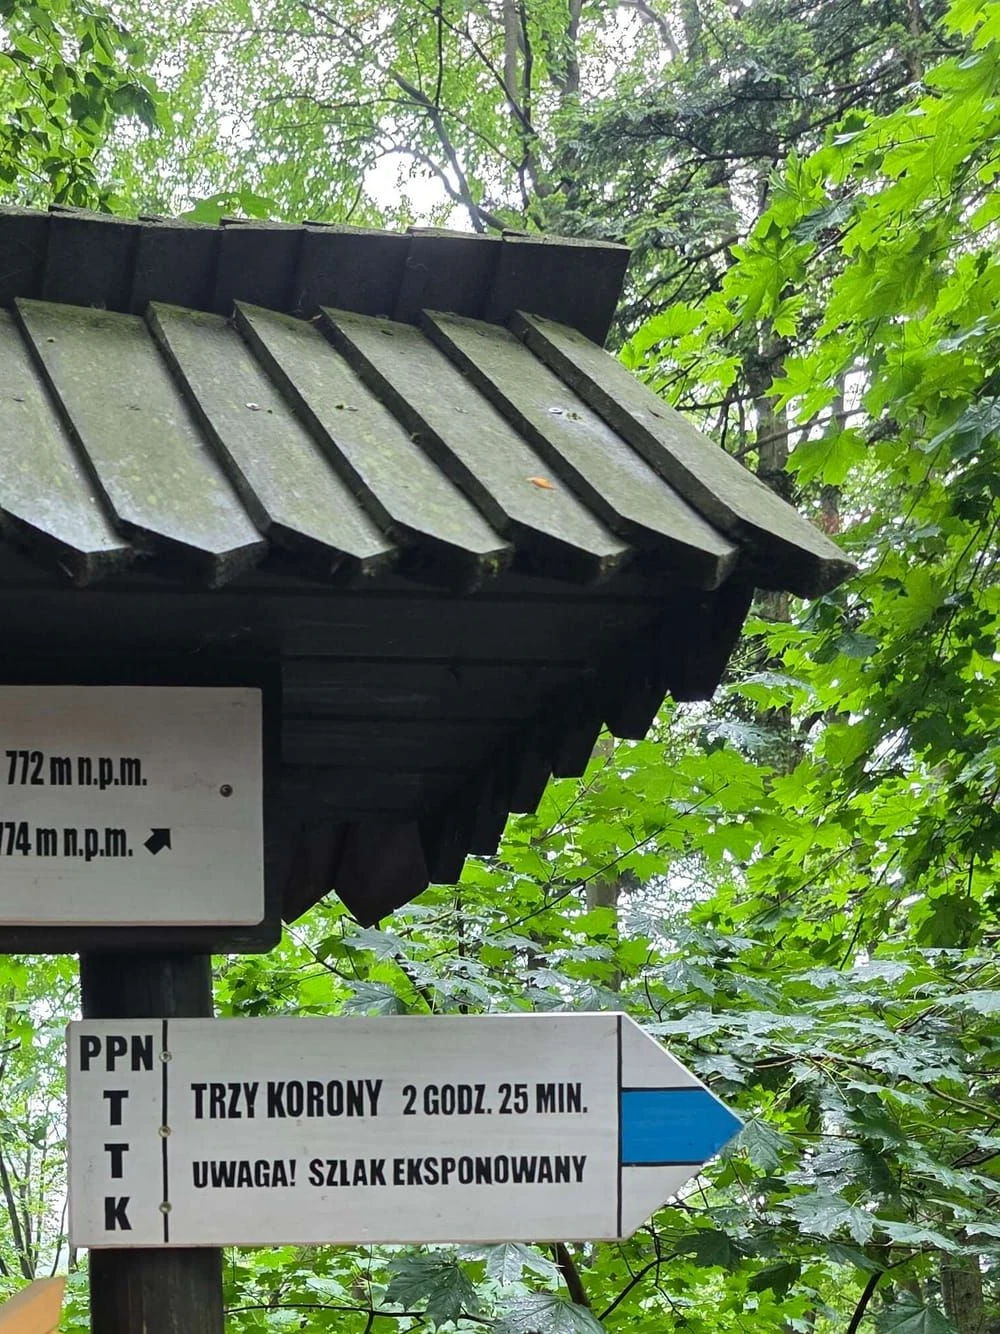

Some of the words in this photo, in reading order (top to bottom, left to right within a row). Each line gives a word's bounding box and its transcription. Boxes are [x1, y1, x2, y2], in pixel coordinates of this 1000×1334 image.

[6, 751, 45, 786] 772
[50, 756, 72, 786] m
[78, 754, 148, 790] n.p.m.
[36, 827, 58, 857] m
[64, 825, 134, 862] n.p.m.
[79, 1034, 154, 1072] PPN
[191, 1082, 260, 1119] TRZY
[267, 1079, 383, 1118] KORONY
[403, 1086, 417, 1116] 2
[423, 1083, 493, 1116] GODZ.
[498, 1083, 528, 1115] 25
[535, 1081, 589, 1115] MIN.
[192, 1158, 295, 1189] UWAGA!
[308, 1158, 386, 1187] SZLAK
[393, 1154, 587, 1186] EKSPONOWANY
